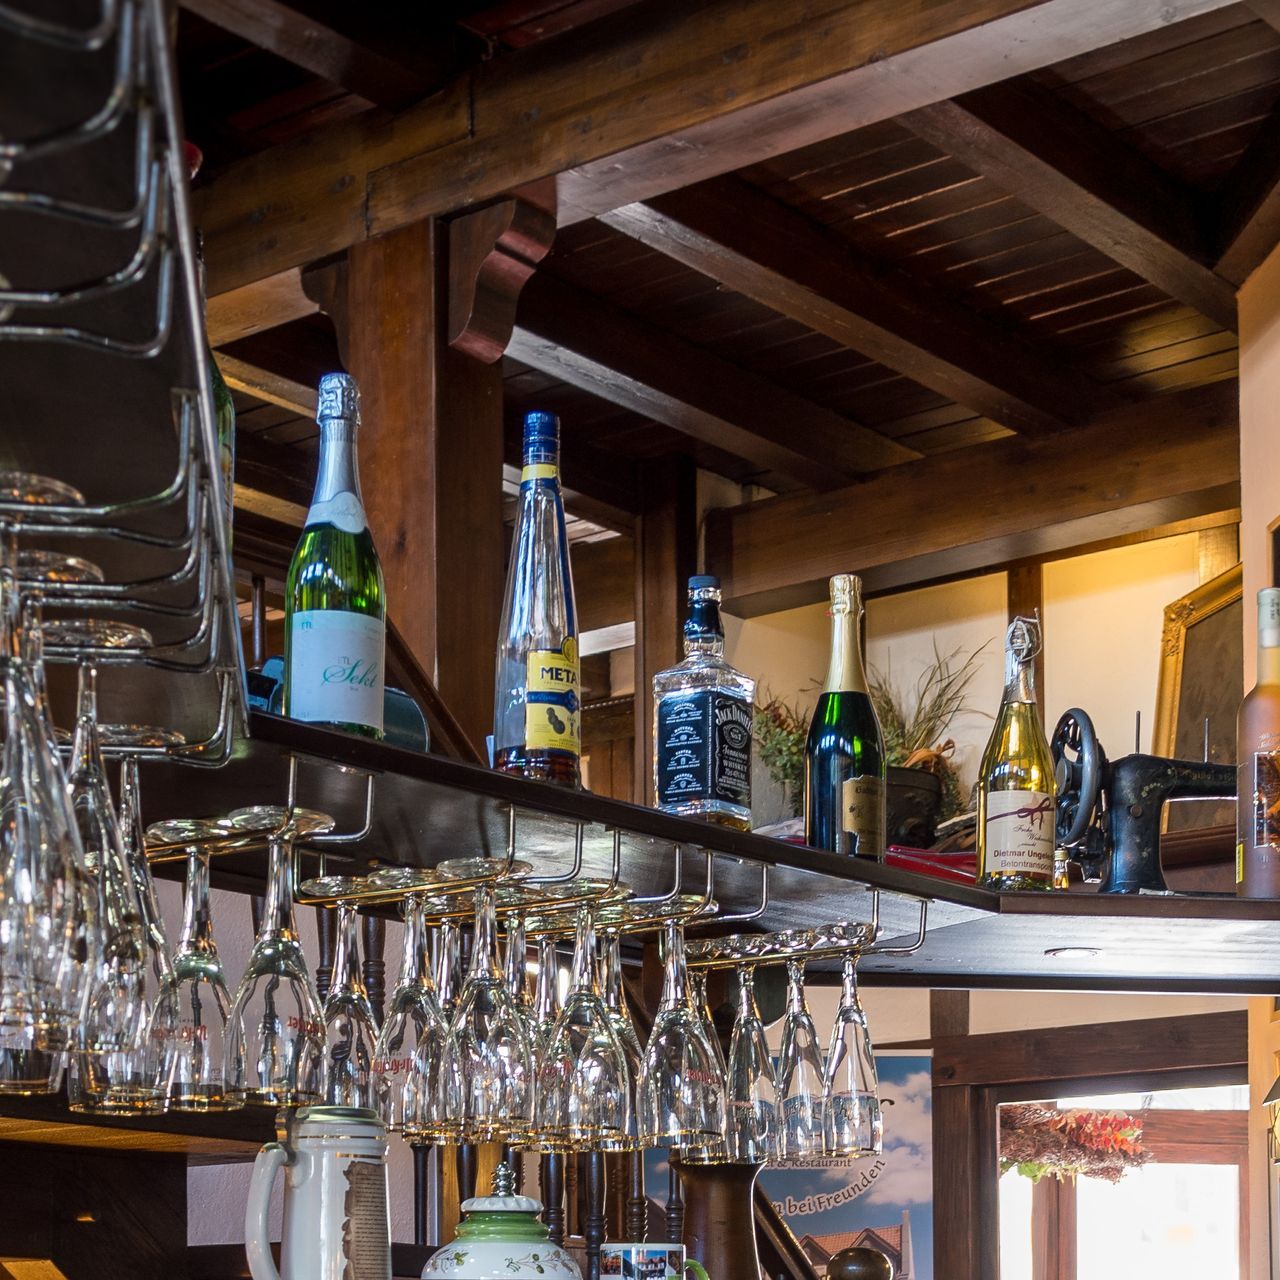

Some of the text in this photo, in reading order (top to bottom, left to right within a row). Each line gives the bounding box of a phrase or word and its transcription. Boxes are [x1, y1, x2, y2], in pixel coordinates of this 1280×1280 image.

[321, 658, 378, 689] Sekt
[541, 667, 578, 685] META
[993, 849, 1025, 857] Dietmar
[788, 1159, 886, 1214] bei Freunden
